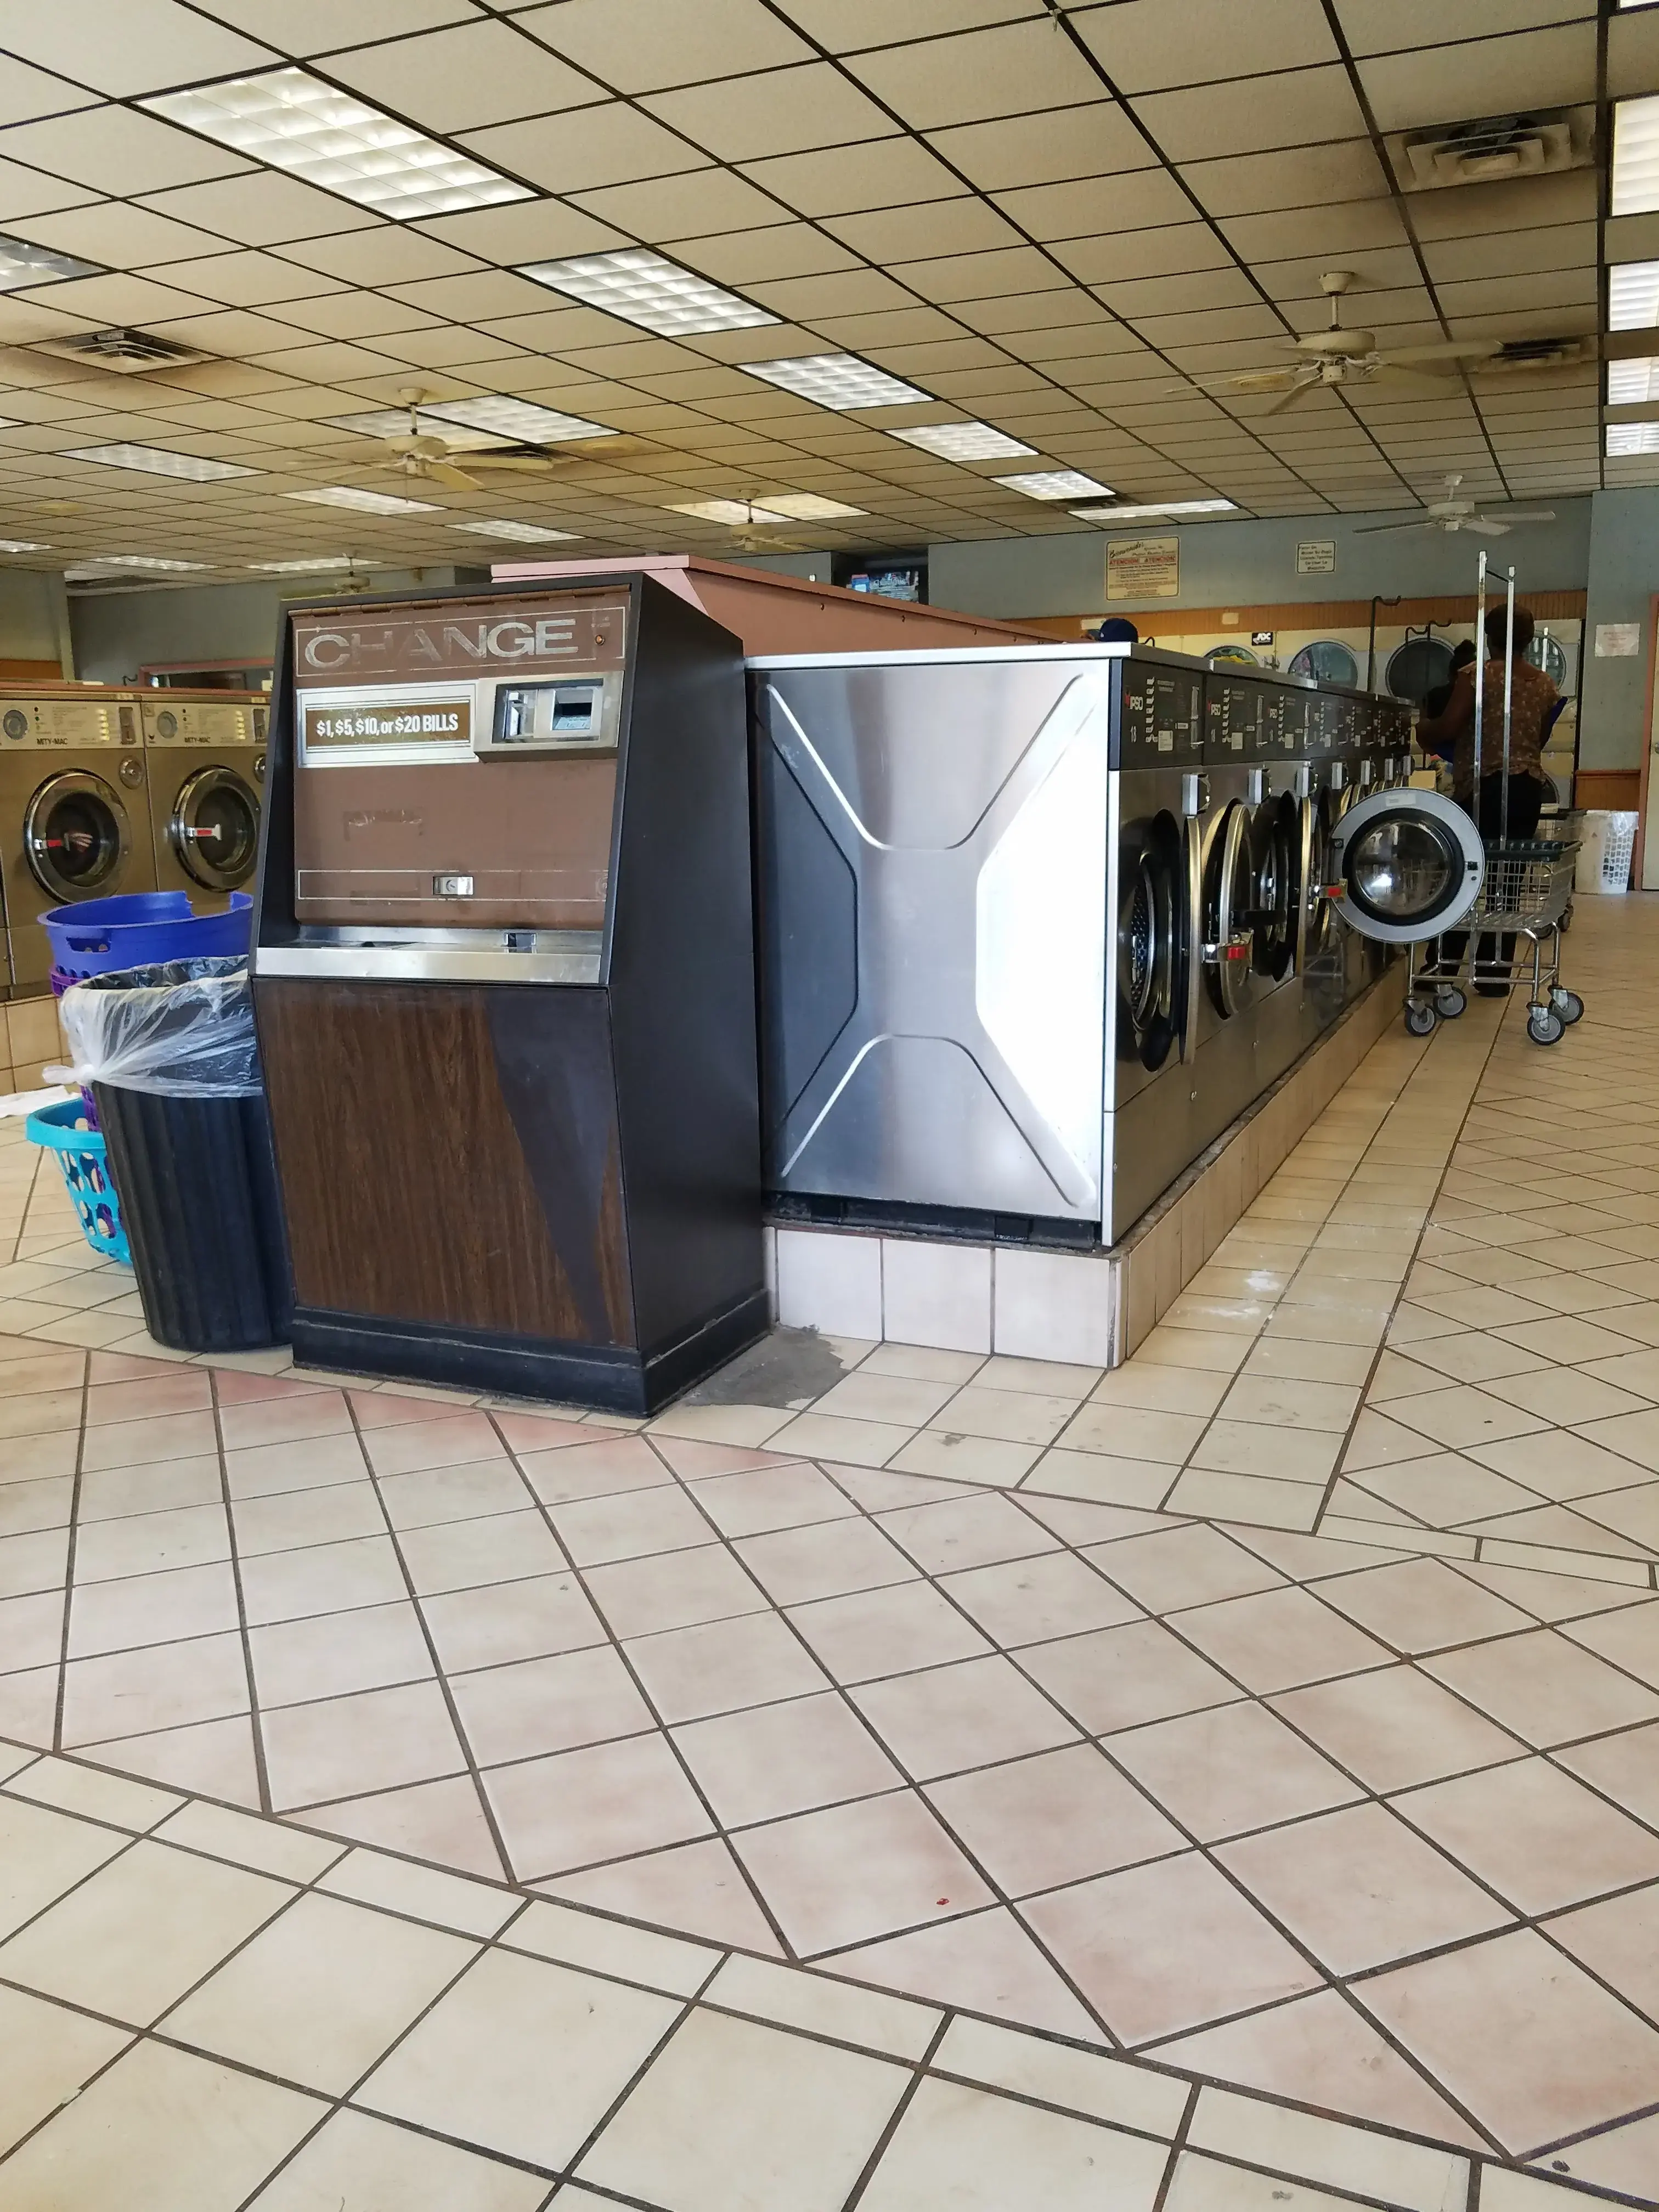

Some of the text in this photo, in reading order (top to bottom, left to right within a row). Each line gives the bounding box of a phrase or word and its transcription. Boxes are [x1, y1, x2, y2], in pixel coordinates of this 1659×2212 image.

[317, 713, 459, 738] $1, $5, $10, or $20 BILLS
